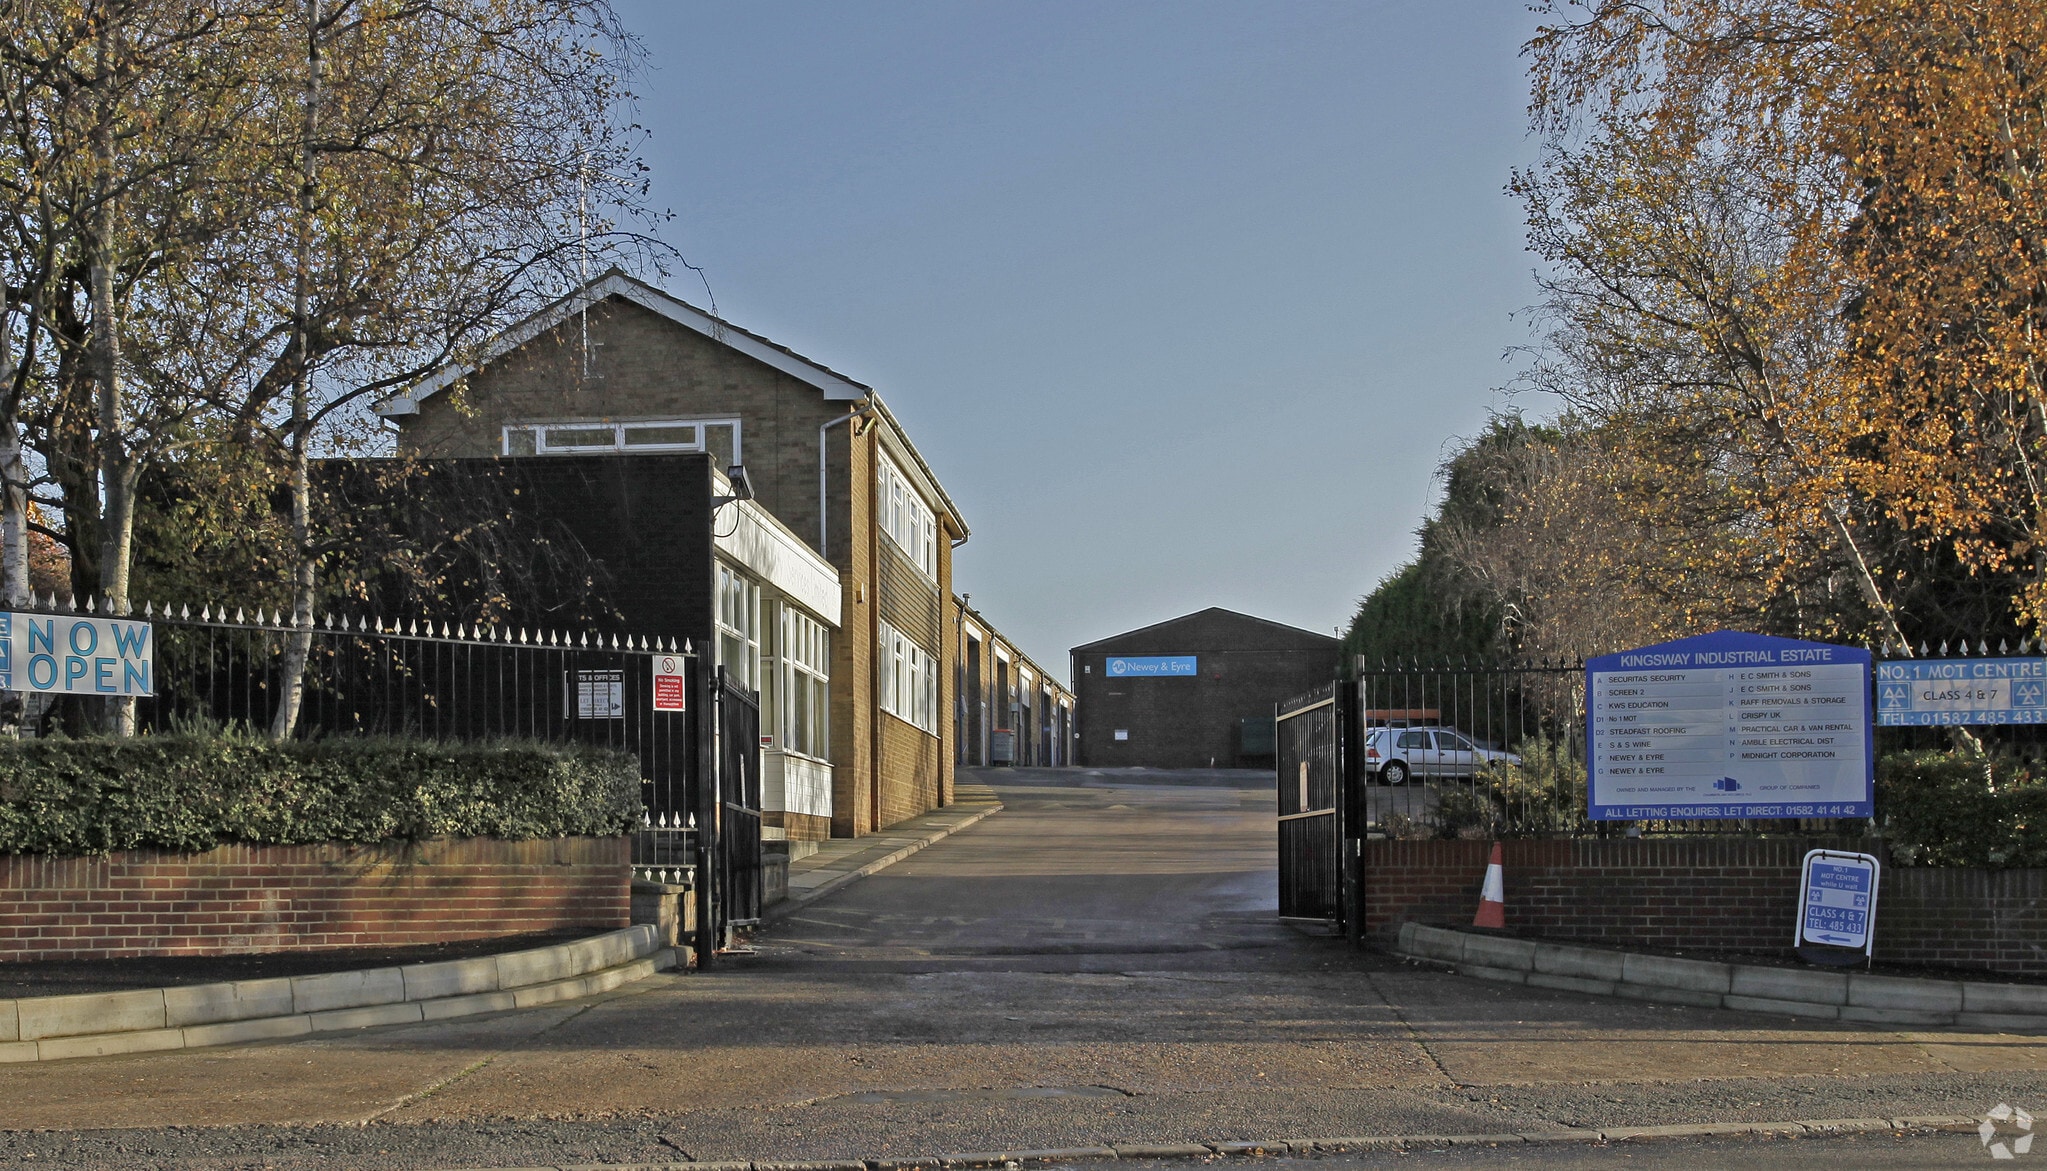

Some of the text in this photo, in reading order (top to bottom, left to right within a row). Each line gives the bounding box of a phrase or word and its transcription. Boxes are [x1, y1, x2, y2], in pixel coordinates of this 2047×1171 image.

[28, 618, 150, 659] NOW
[1621, 648, 1832, 667] KINGSWAY INDUSTRIAL ESTATE
[1127, 661, 1191, 673] Newey & Eyre
[1880, 662, 2042, 679] NO.1 MOT CENTRE
[28, 653, 149, 694] OPEN
[1609, 675, 1648, 683] SECURITAS
[1650, 674, 1686, 682] SECURITY
[1923, 689, 1998, 700] CLASS 4 & 7
[1628, 701, 1669, 709] EDUCATION
[1811, 697, 1846, 705] STORAGE
[1741, 712, 1768, 720] CRISPY
[1880, 711, 2042, 725] TEL: 01582 485 433
[1741, 725, 1780, 733] PRACTICAL
[1825, 723, 1853, 731] RENTAL
[1781, 751, 1835, 759] CORPORATION
[1605, 808, 1623, 817] ALL
[1627, 807, 1667, 817] LETTING
[1724, 807, 1742, 816] LET
[1746, 806, 1783, 815] DIRECT:
[1786, 806, 1813, 815] 01582
[1817, 806, 1827, 814] 41
[1830, 806, 1840, 814] 41
[1844, 805, 1855, 815] 42
[1836, 874, 1859, 882] CENTRE
[1809, 907, 1864, 921] CLASS 4 & 7
[1809, 918, 1861, 933] TEL: 485 433
